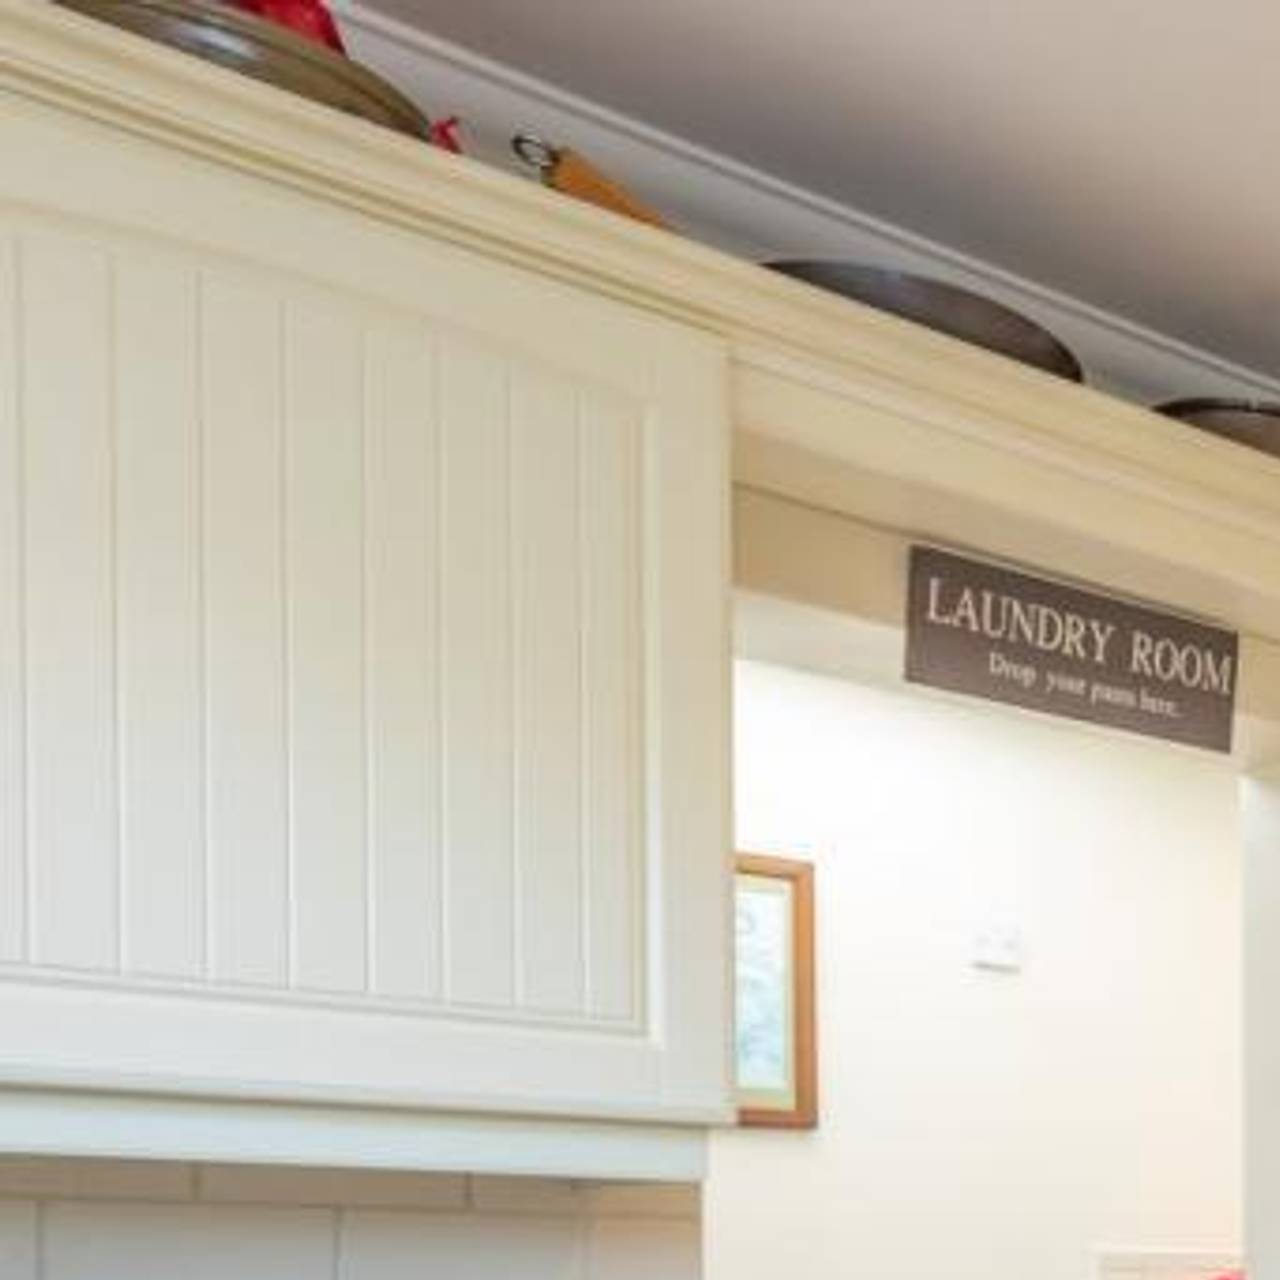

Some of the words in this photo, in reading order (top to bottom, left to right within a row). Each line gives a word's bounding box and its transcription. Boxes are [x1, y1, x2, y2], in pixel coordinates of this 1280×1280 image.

[928, 577, 1116, 662] LAUNDRY
[1131, 630, 1232, 695] ROOM
[989, 652, 1036, 688] Drop
[1046, 670, 1087, 696] your
